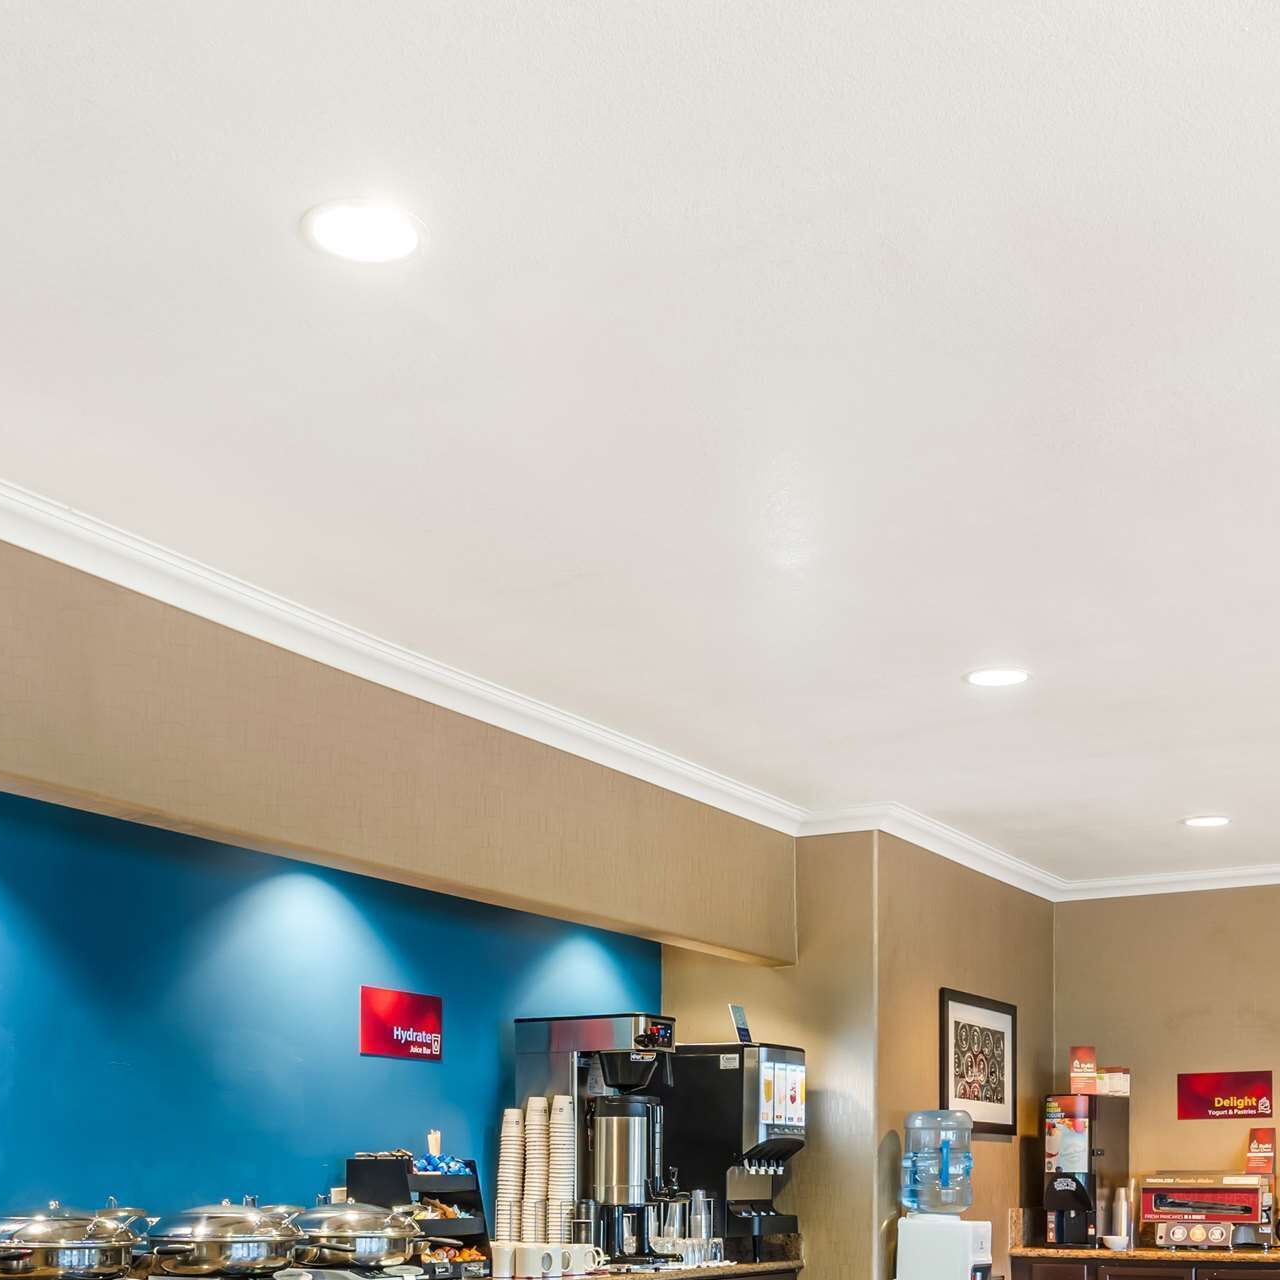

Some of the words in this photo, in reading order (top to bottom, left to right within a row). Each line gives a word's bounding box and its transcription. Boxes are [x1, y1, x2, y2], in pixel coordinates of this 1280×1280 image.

[393, 1026, 432, 1043] Hydrate
[1214, 1096, 1257, 1109] Delight
[1208, 1109, 1227, 1117] Yogurt
